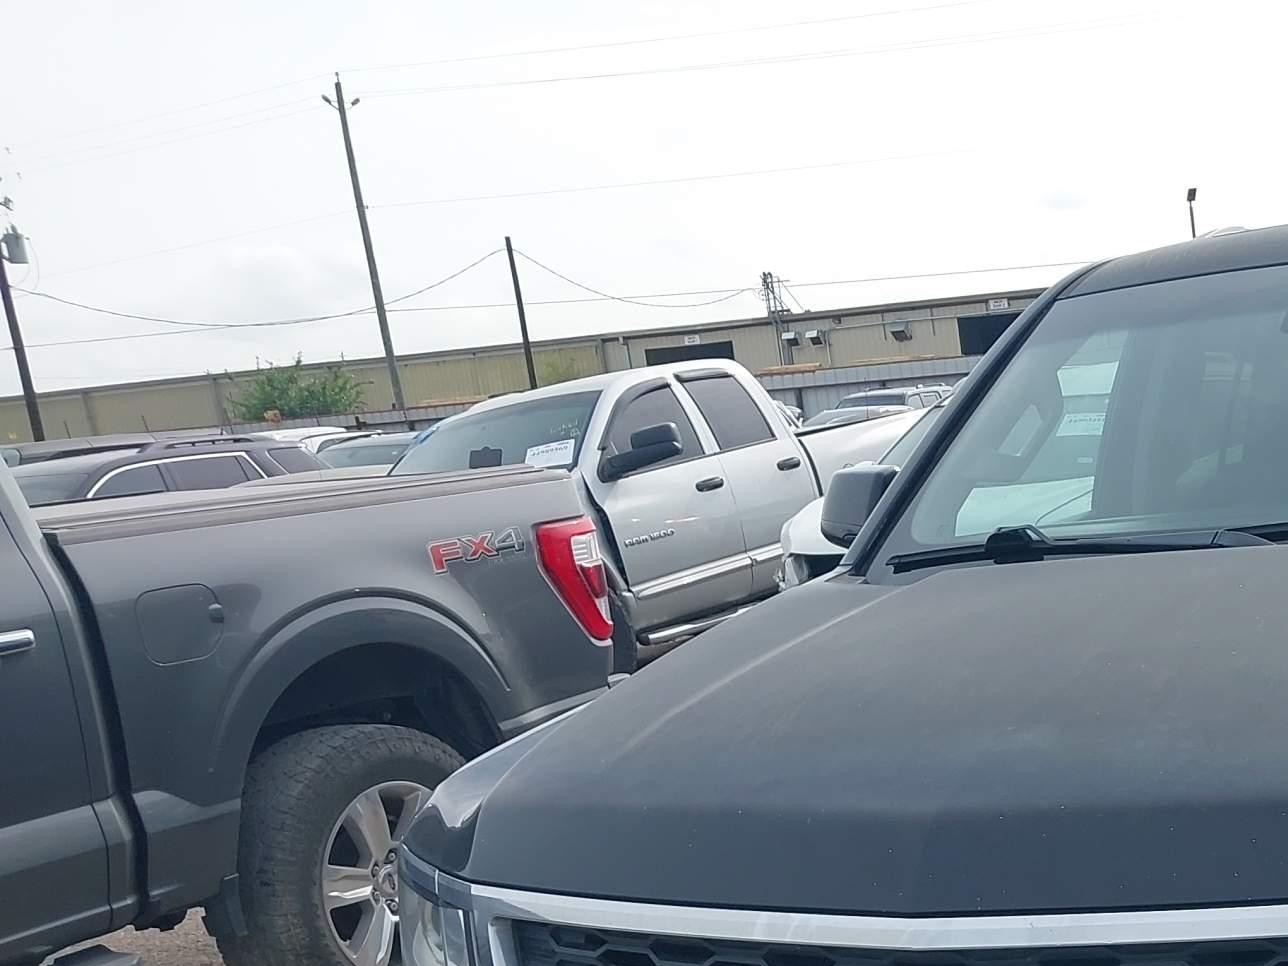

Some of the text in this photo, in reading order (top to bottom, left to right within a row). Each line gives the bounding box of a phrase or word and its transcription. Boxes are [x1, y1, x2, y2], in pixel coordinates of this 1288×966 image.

[427, 526, 525, 576] FX4
[624, 528, 676, 548] RAM 1500
